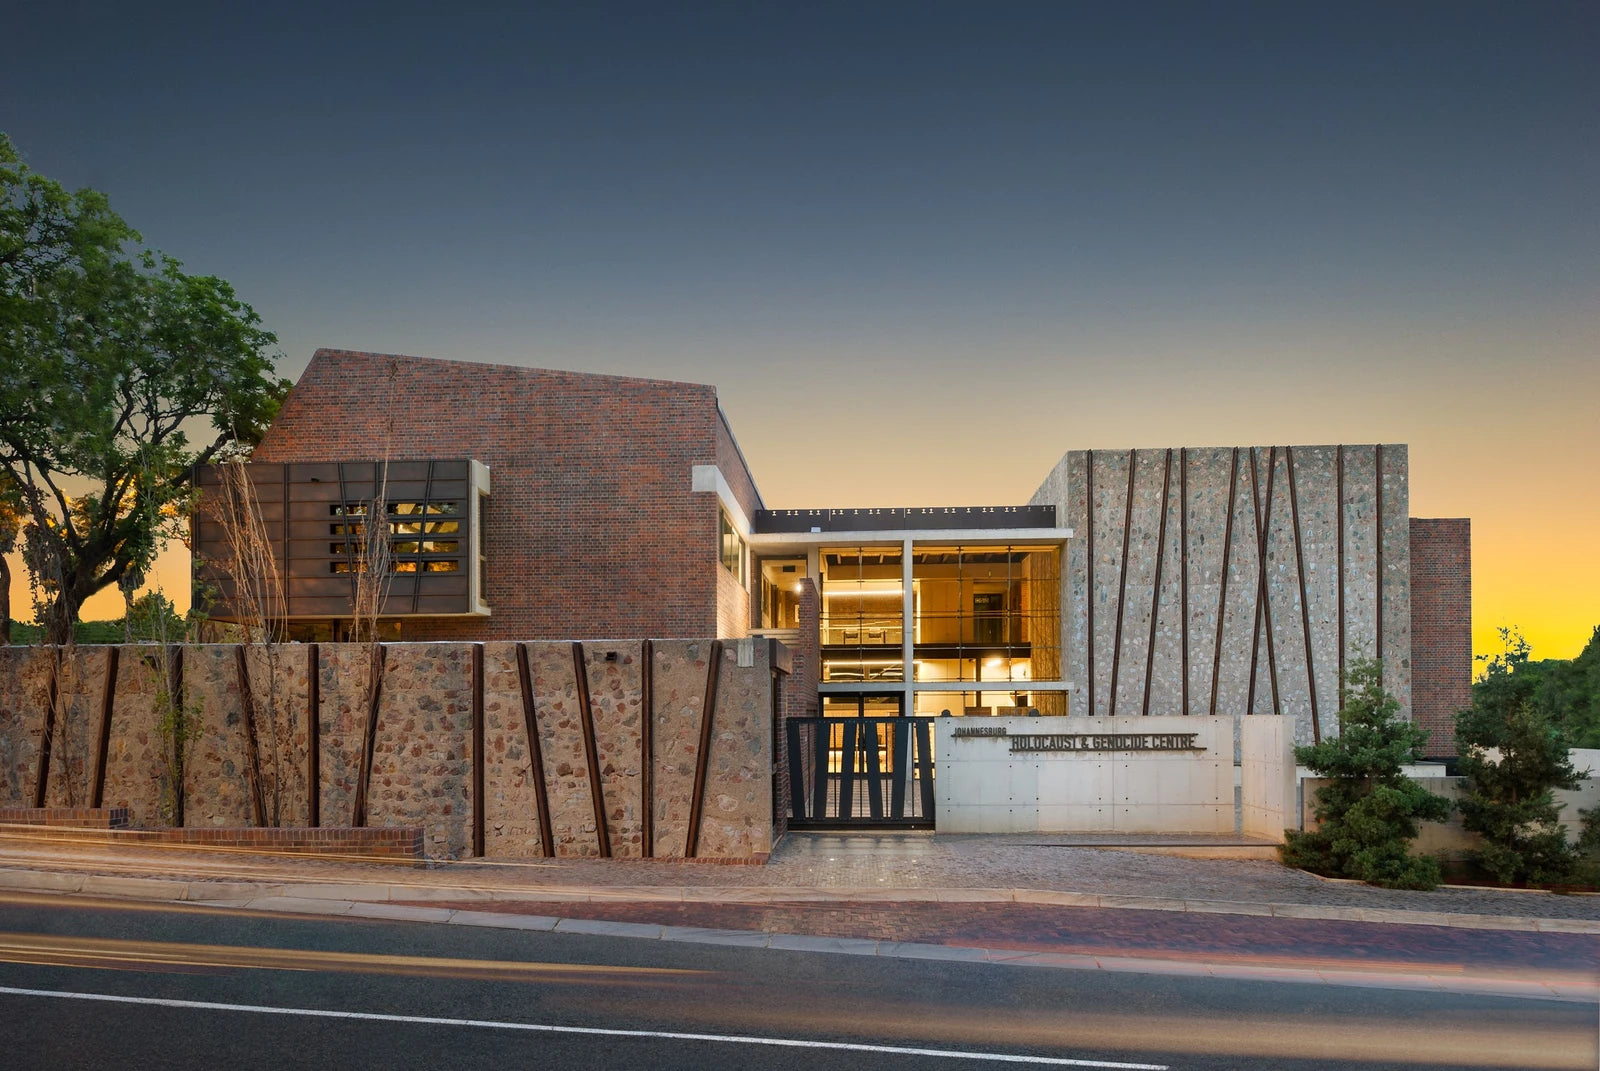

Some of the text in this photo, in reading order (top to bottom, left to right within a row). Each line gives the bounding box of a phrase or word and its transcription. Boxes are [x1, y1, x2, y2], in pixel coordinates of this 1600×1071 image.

[954, 727, 1007, 736] JOHANNESBURG
[1012, 735, 1195, 750] HOLOCAUST & GENOCIDE CENTRE
